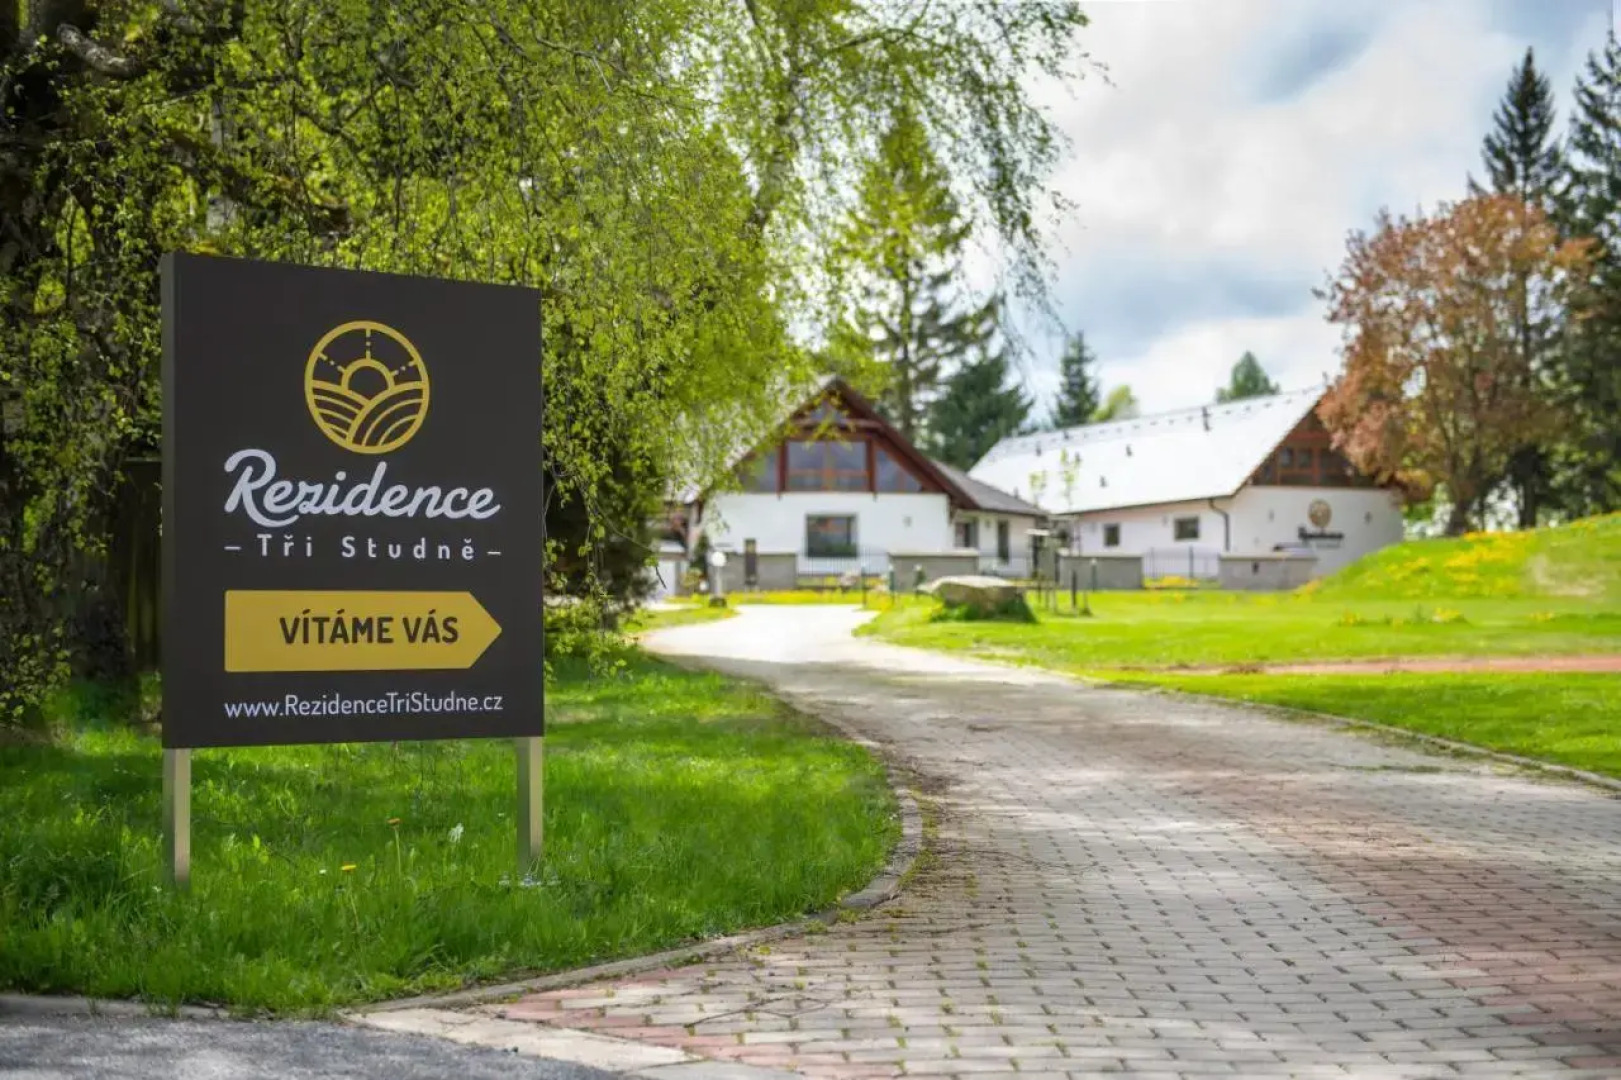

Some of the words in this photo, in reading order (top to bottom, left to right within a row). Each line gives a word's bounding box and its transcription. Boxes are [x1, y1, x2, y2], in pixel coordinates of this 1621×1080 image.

[224, 448, 501, 527] Rezidence
[257, 533, 313, 557] Tři
[341, 536, 475, 560] Studně
[279, 608, 394, 645] VÍTÁME
[402, 608, 459, 644] VÁS
[224, 691, 503, 719] www.RezidenceTriStudne.cz
